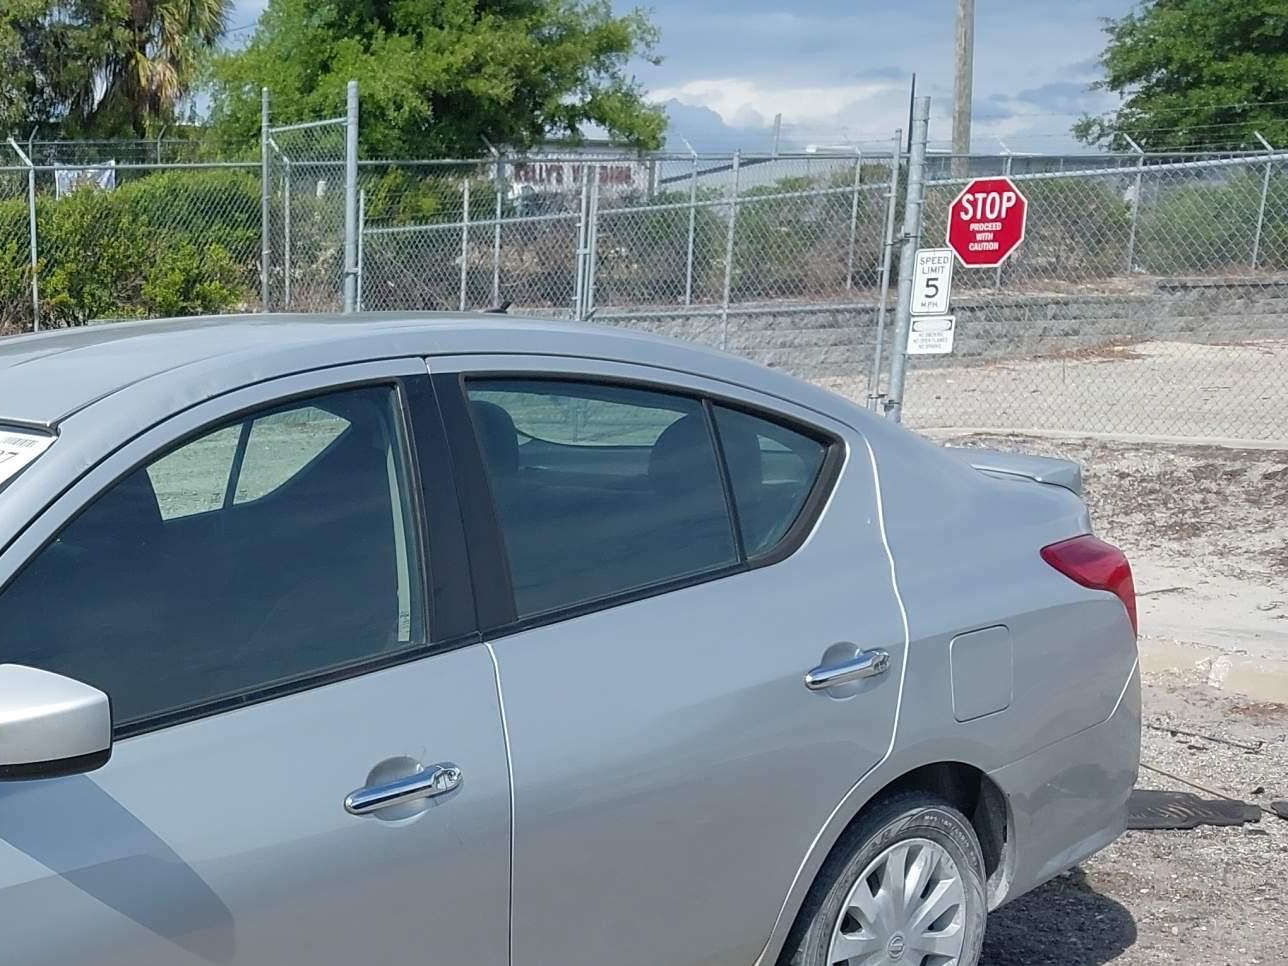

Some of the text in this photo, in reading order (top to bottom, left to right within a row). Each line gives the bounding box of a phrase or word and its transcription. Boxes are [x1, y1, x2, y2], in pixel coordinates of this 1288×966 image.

[960, 192, 1016, 221] STOP
[969, 222, 1002, 232] PROCEED
[975, 232, 994, 241] WITH
[968, 241, 1000, 251] CAUTION
[920, 256, 950, 267] SPEED
[922, 266, 945, 275] LIMIT
[924, 277, 939, 298] 5
